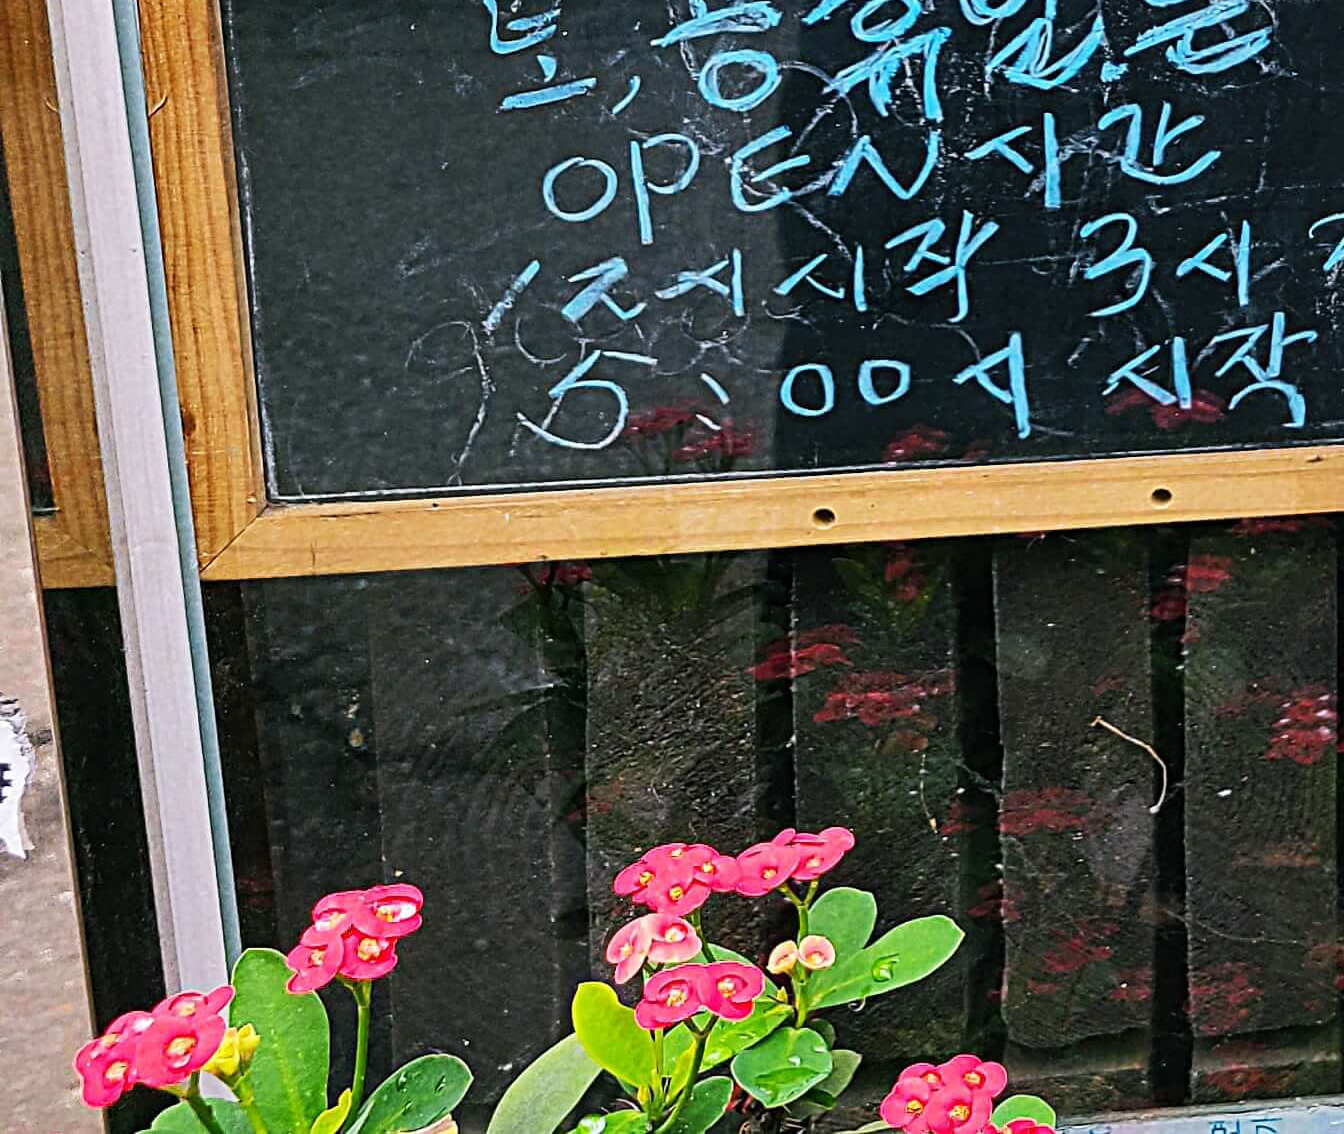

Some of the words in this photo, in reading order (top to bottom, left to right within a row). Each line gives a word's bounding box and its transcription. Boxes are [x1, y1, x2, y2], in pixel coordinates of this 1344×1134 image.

[543, 124, 940, 244] OPEN
[965, 101, 1222, 208] 시간
[1080, 212, 1250, 316] 3시
[1103, 311, 1317, 428] 시작
